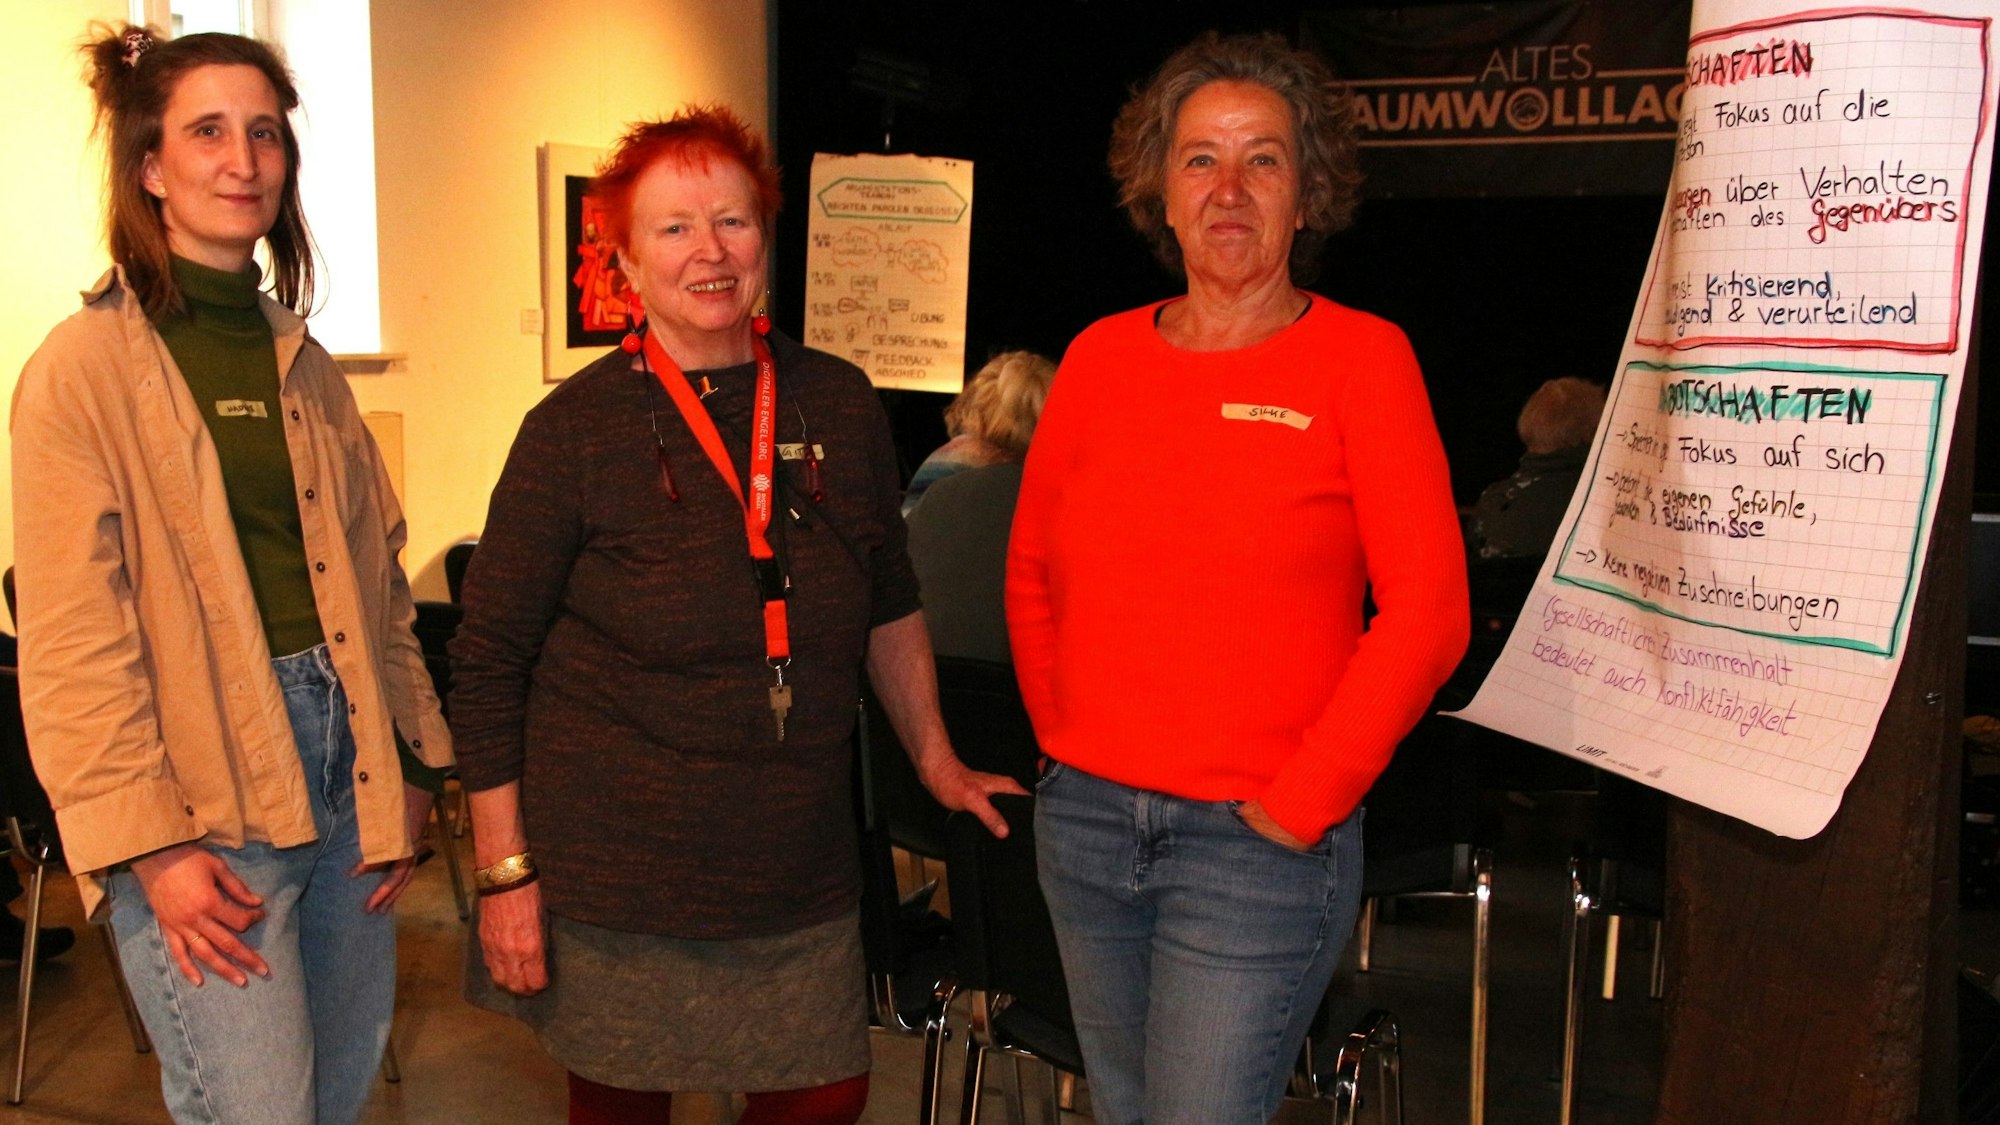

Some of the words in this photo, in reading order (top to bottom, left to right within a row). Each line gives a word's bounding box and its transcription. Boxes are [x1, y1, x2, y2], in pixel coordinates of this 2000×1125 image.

[1479, 43, 1593, 83] ALTES
[1689, 43, 1812, 88] CHAFTEN
[1353, 85, 1686, 133] AUMWOLLLA
[1714, 101, 1770, 129] Fokus
[1783, 88, 1830, 126] auf
[1842, 88, 1891, 122] die
[1726, 174, 1780, 206] über
[1800, 160, 1949, 200] Verhalten
[1750, 205, 1785, 229] des
[1728, 298, 1745, 322] &
[1758, 292, 1917, 326] verurteilend
[875, 354, 935, 367] FEEDBACK
[1248, 407, 1288, 419] SILKE
[1678, 436, 1738, 465] Fokus
[1764, 434, 1806, 467] auf
[1826, 442, 1886, 475] sich
[1678, 567, 1840, 632] Zuschreibungen
[1531, 635, 1597, 677] bedeutet
[1603, 667, 1647, 696] auch
[1576, 744, 1608, 758] LIMIT
